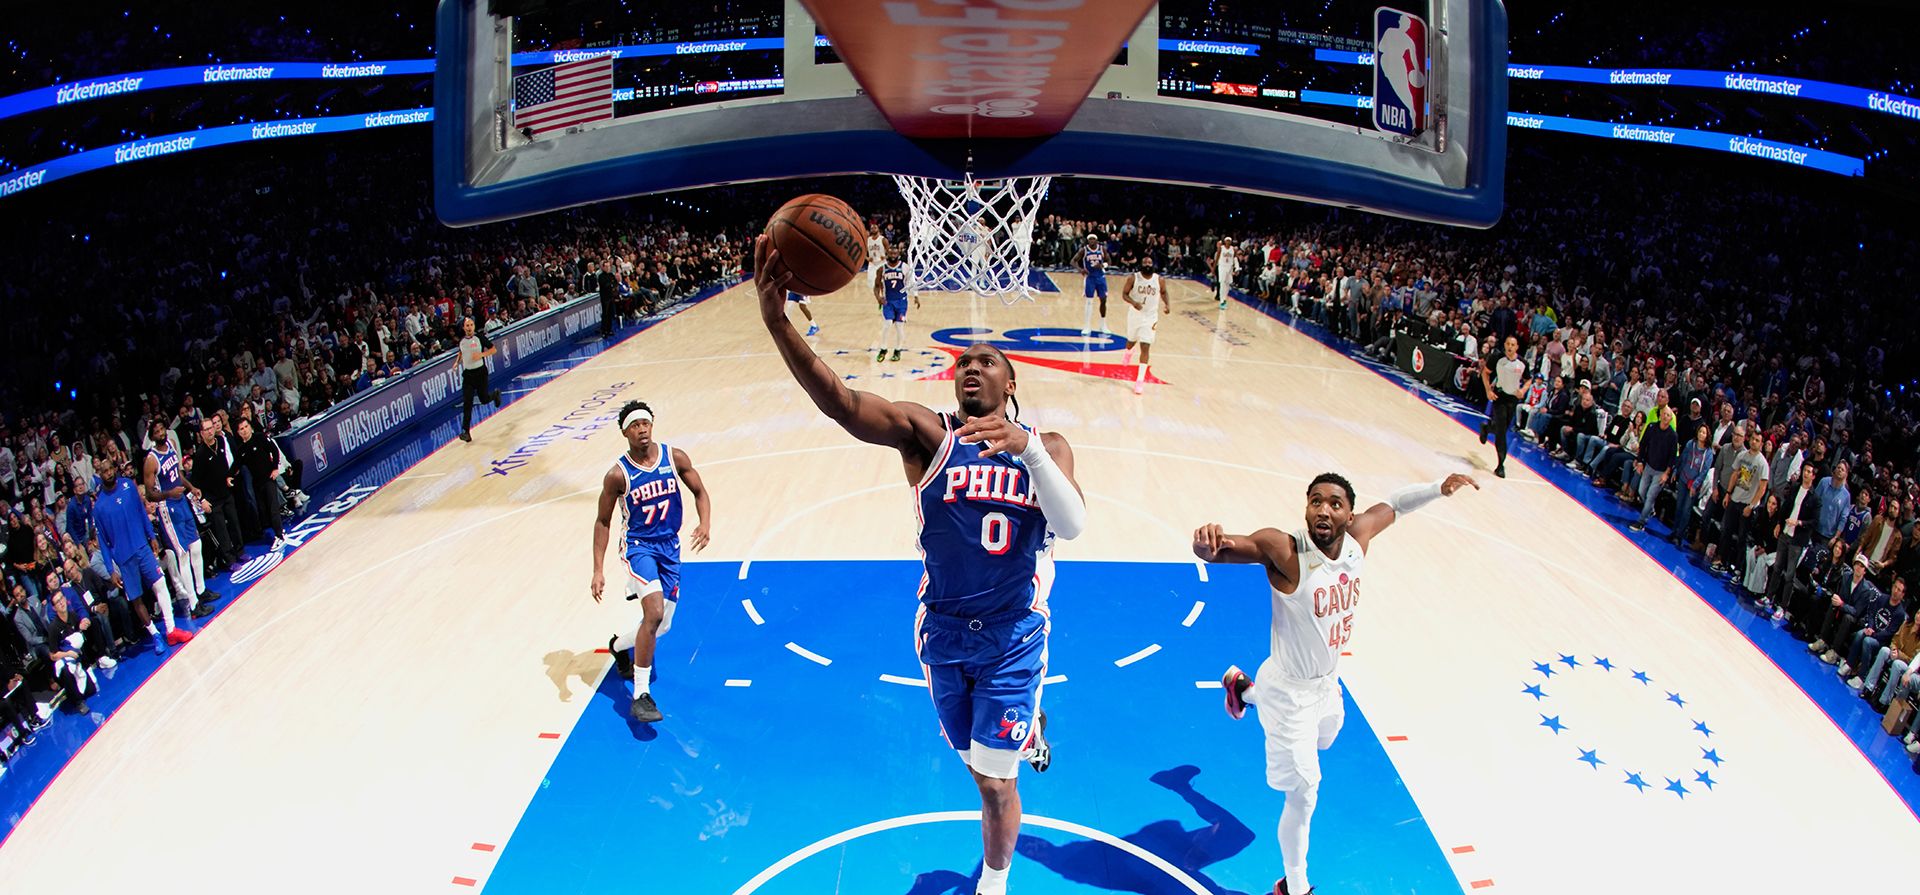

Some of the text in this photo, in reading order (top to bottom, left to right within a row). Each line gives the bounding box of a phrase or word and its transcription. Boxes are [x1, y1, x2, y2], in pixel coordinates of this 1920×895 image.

[674, 40, 747, 55] ticketmaster
[1177, 40, 1249, 55] ticketmaster
[203, 64, 274, 83] ticketmaster
[321, 62, 386, 79] ticketmaster
[1610, 70, 1672, 86] ticketmaster
[56, 76, 143, 104] ticketmaster
[1724, 73, 1802, 97] ticketmaster
[250, 120, 317, 139] ticketmaster
[364, 109, 429, 128] ticketmaster
[1381, 103, 1407, 129] NBA
[1612, 124, 1676, 144] ticketmaster
[114, 133, 196, 164] ticketmaster
[1728, 136, 1808, 165] ticketmaster
[809, 210, 863, 267] Wilson
[890, 280, 898, 289] 7
[515, 322, 562, 361] NBAStore.com
[421, 369, 448, 408] SHOP
[336, 392, 416, 456] NBAStore.com
[481, 424, 575, 478] xfinity
[169, 466, 180, 484] 21
[629, 477, 677, 506] PHILA
[280, 483, 380, 548] AT&T
[641, 498, 671, 526] 77
[980, 511, 1012, 555] 0
[1313, 577, 1361, 618] CAVS
[1328, 612, 1354, 650] 45
[997, 717, 1029, 742] 76
